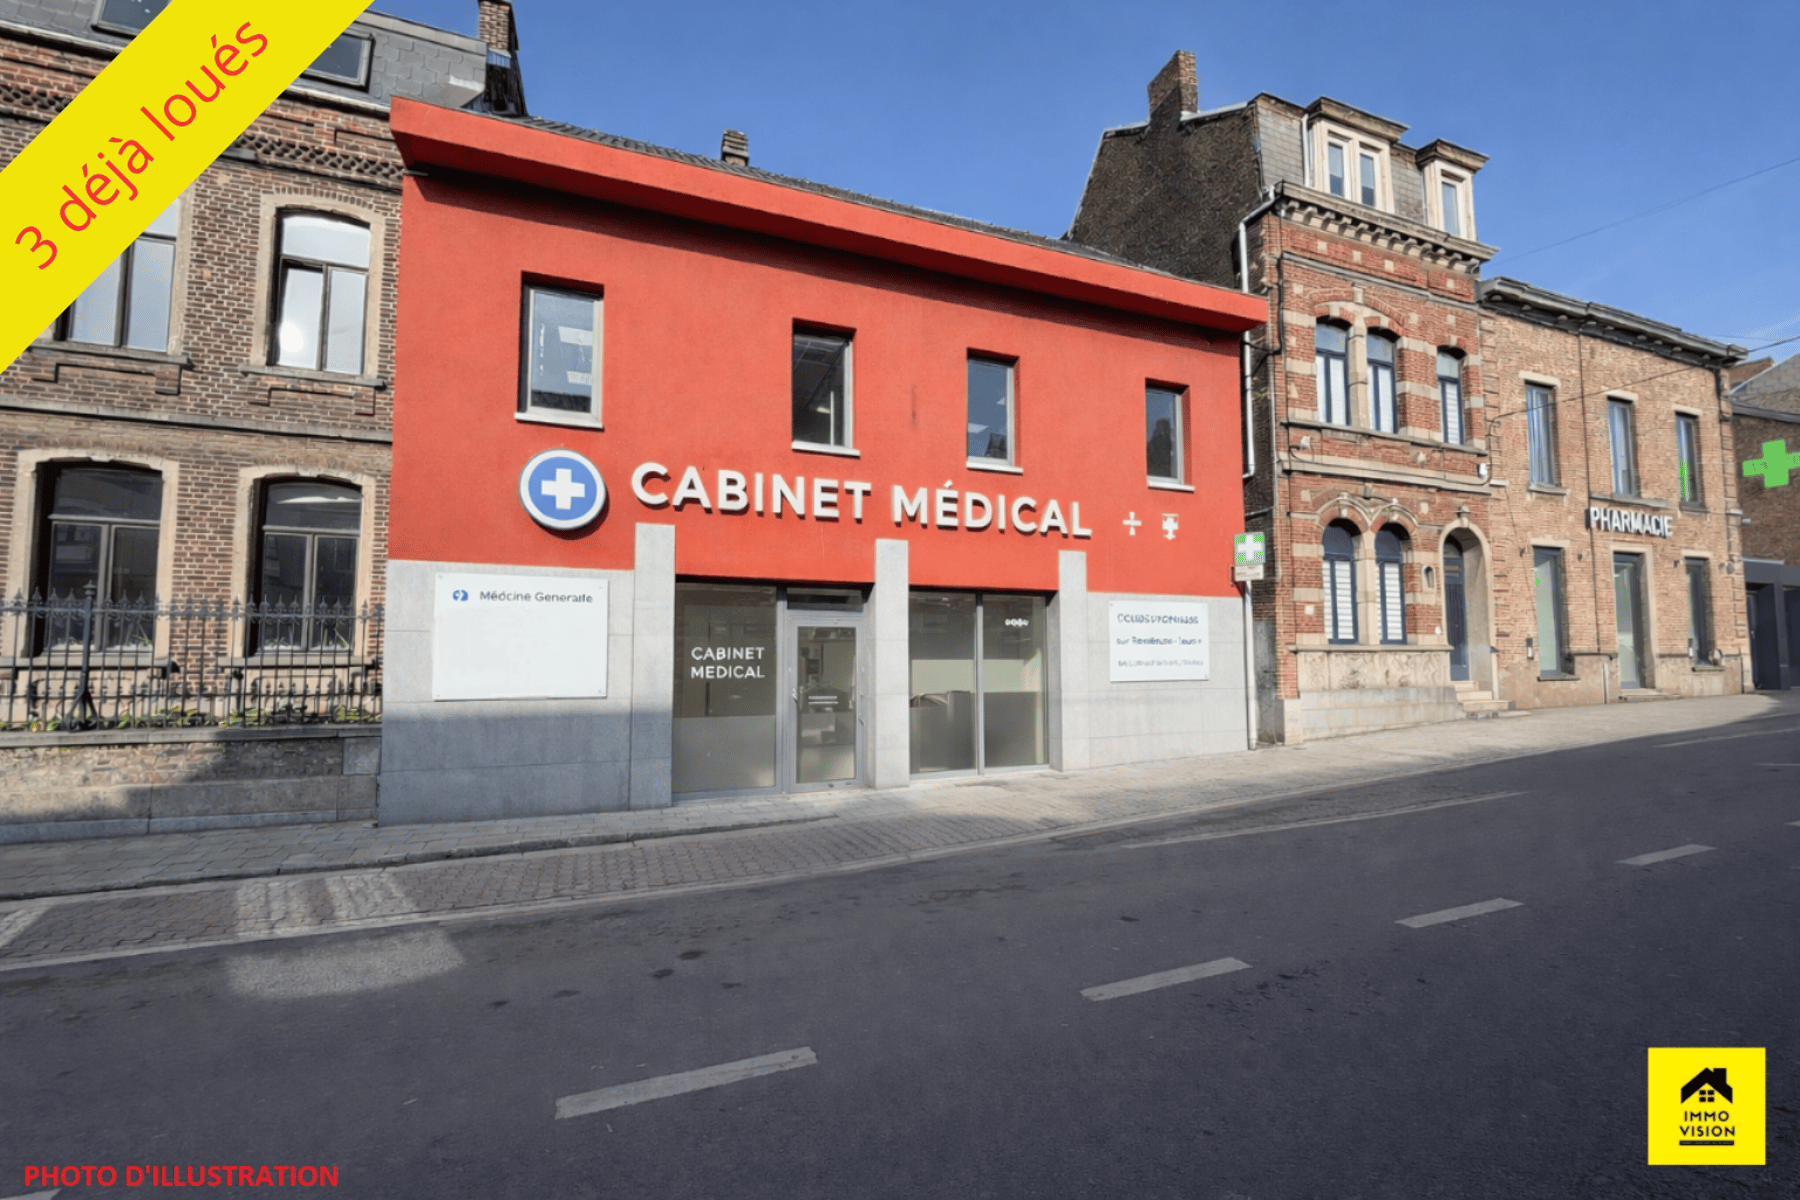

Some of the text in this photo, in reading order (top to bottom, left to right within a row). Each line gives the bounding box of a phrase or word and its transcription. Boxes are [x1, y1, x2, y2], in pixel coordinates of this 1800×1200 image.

[631, 462, 1093, 537] CABINET MÉDICAL
[1590, 507, 1673, 537] PHARMACIE
[691, 646, 765, 661] CABINET
[690, 665, 765, 679] MEDICAL
